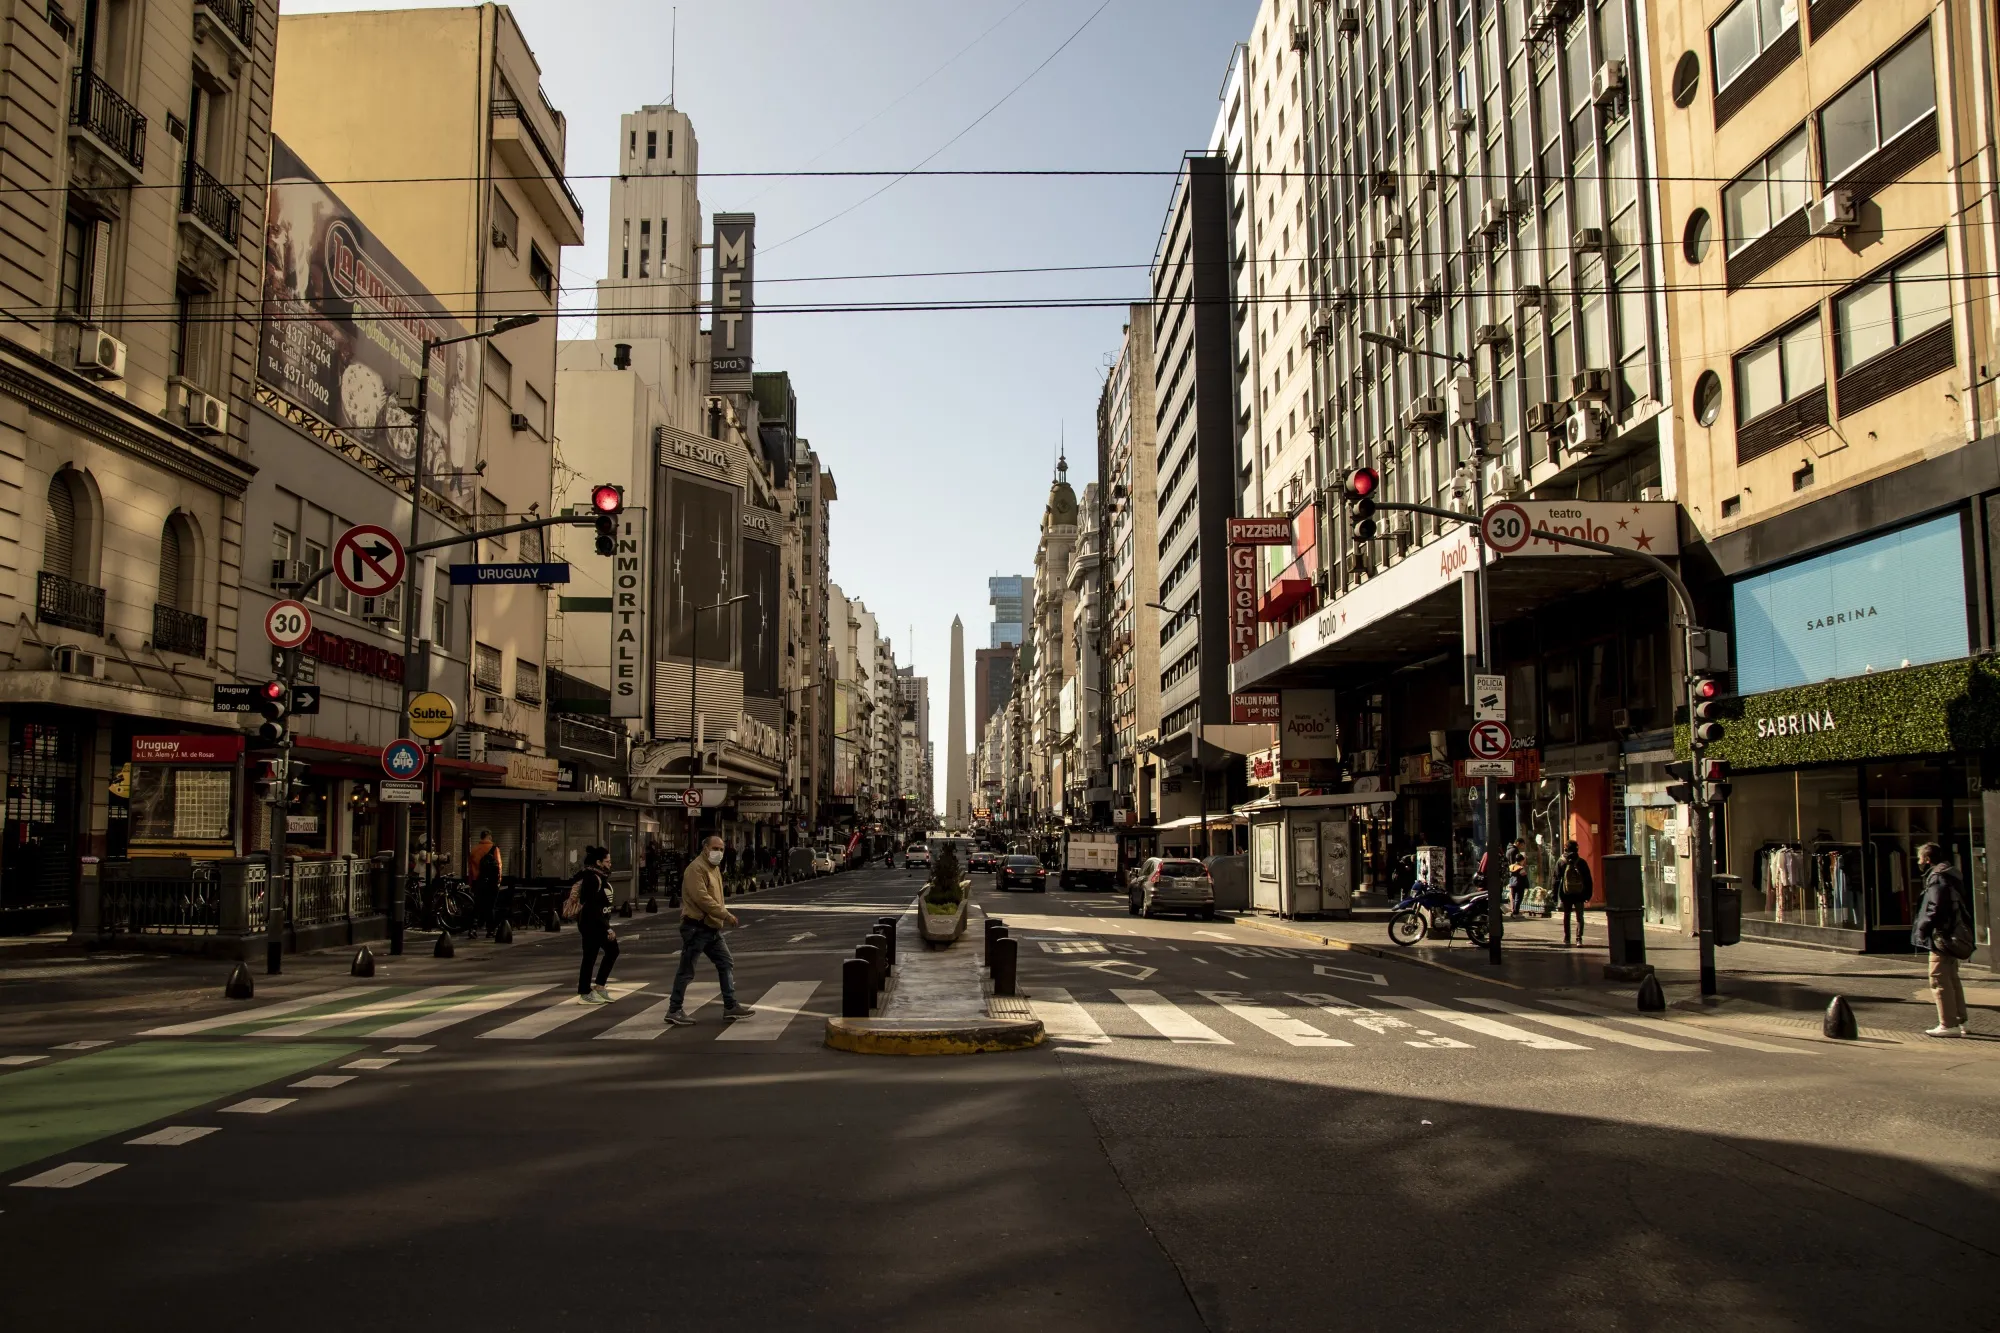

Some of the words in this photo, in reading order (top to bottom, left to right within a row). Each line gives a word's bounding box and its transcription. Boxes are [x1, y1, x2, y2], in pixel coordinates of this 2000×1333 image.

[719, 230, 746, 351] MET
[281, 343, 299, 362] Callao
[713, 361, 737, 370] sura
[283, 362, 329, 405] 4371-0202
[674, 440, 697, 461] MET
[697, 446, 725, 467] sura
[744, 514, 765, 530] sura
[1549, 509, 1582, 519] teatro
[1232, 524, 1290, 538] PIZZERIA
[1492, 518, 1520, 538] 30
[1533, 518, 1609, 552] Apolo
[1441, 539, 1468, 581] Apolo
[477, 568, 540, 580] URUGUAY
[617, 522, 638, 697] INMORTALES
[1807, 606, 1878, 631] SABRINA
[274, 614, 301, 634] 30
[1318, 611, 1337, 644] Apolo
[217, 686, 250, 695] Uruguay
[1235, 696, 1258, 705] SALON
[1259, 695, 1279, 705] FAMIL
[217, 703, 231, 711] 500
[413, 708, 447, 719] Subte
[1287, 719, 1324, 736] Apolo
[1758, 709, 1836, 738] SABRINA
[136, 740, 180, 751] Uruguay
[513, 759, 542, 781] Dickens
